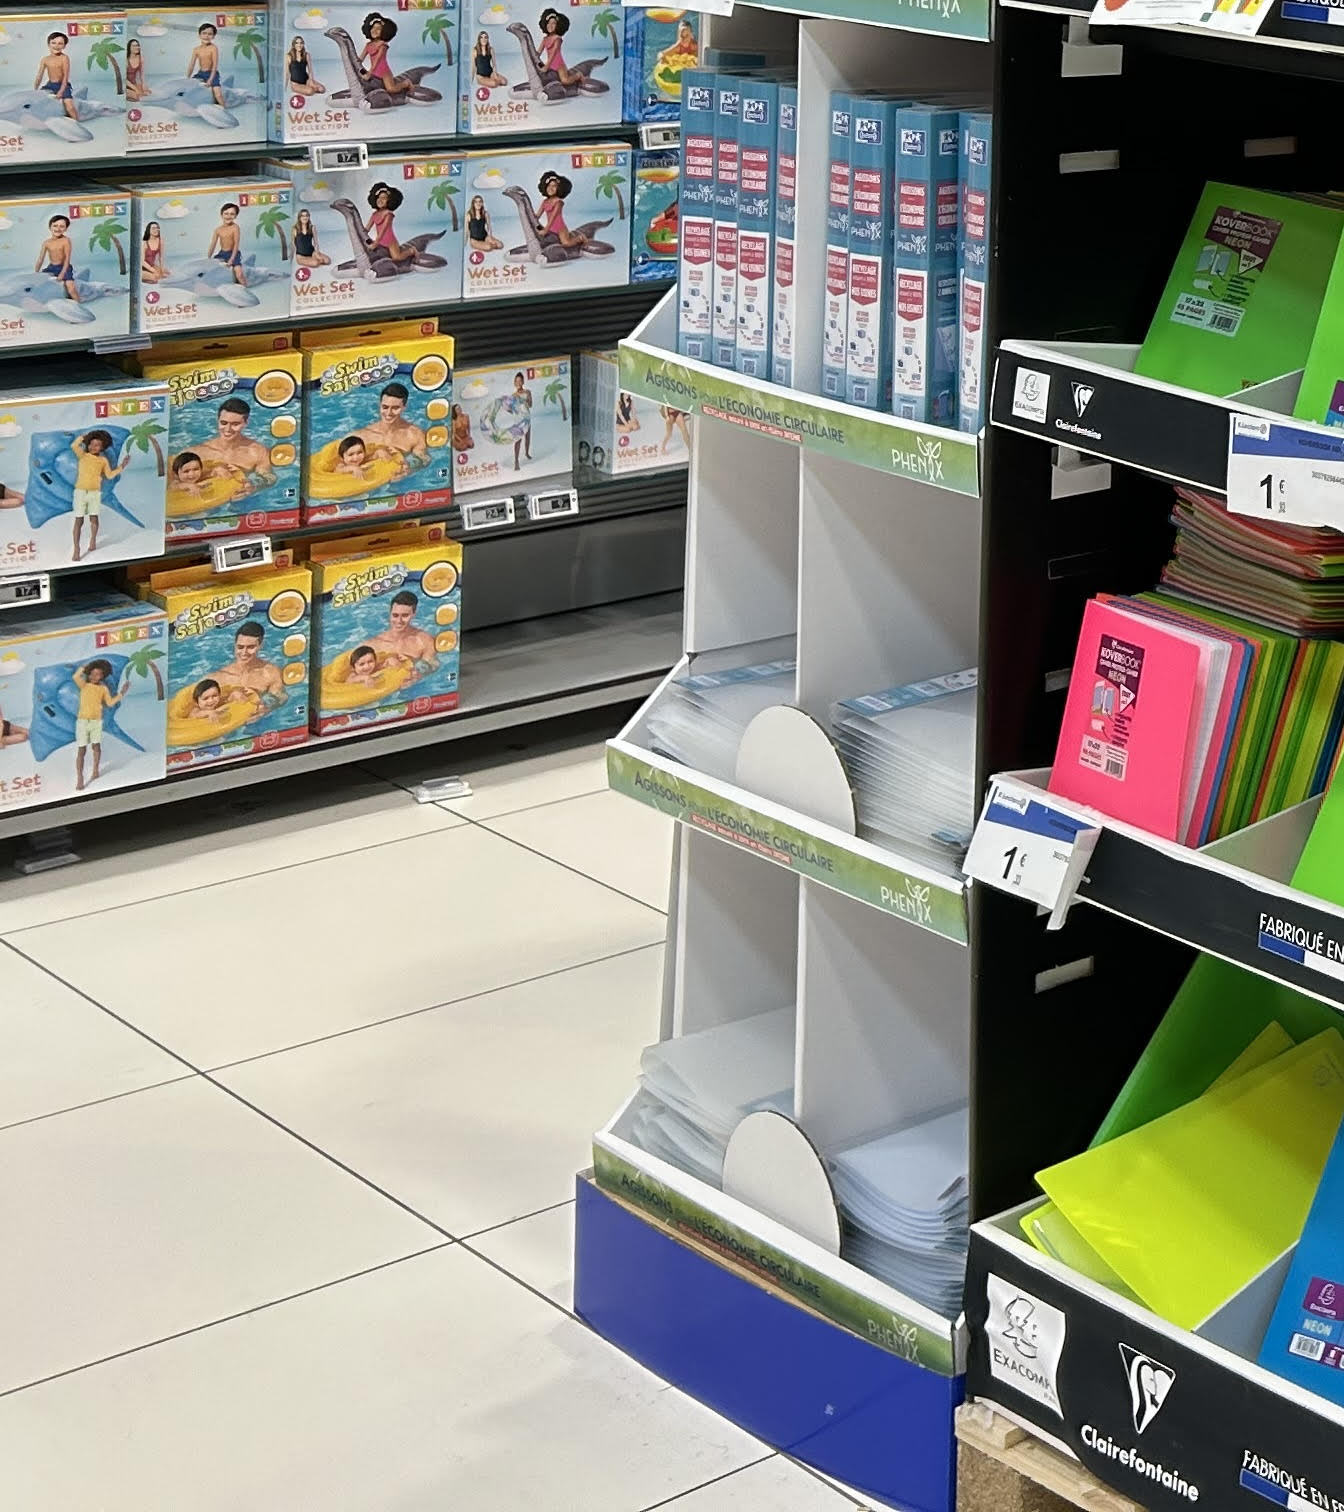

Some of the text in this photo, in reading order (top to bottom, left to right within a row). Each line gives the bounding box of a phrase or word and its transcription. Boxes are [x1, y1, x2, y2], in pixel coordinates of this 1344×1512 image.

[66, 21, 125, 37] INTEX
[215, 13, 267, 29] INTEX
[288, 108, 350, 125] Wet Set
[474, 101, 530, 118] Wet Set
[125, 121, 179, 136] Wet Set
[0, 135, 24, 147] Set
[571, 152, 628, 170] INTEX
[403, 162, 463, 181] INTEX
[239, 190, 290, 208] INTEX
[68, 202, 128, 221] INTEX
[467, 263, 527, 281] Wet Set
[293, 280, 355, 297] Wet Set
[143, 302, 198, 318] Wet Set
[0, 317, 25, 330] Set
[336, 355, 380, 378] Swim
[168, 369, 217, 389] Swim
[321, 375, 361, 397] Safe
[95, 397, 166, 419] INTEX
[645, 371, 698, 400] AGISSONS
[783, 415, 845, 445] CIRCULAIRE
[1259, 473, 1273, 510] 1
[7, 538, 36, 557] Set
[346, 563, 390, 588] Swim
[189, 594, 235, 620] Swim
[333, 585, 371, 609] Safe
[95, 625, 165, 651] INTEX
[175, 616, 215, 640] Safe
[13, 772, 42, 790] Set
[634, 771, 688, 808] AGISSONS
[772, 836, 835, 874] CIRCULAIRE
[1003, 845, 1018, 880] 1
[1258, 909, 1326, 957] FABRIQUÉ
[621, 1174, 674, 1216] AGISSONS
[757, 1254, 822, 1300] CIRCULAIRE
[1303, 1317, 1333, 1337] NEON
[1080, 1423, 1200, 1503] Clairefontaine
[1241, 1448, 1308, 1498] FABRIQUÉ
[1309, 1484, 1330, 1511] EN
